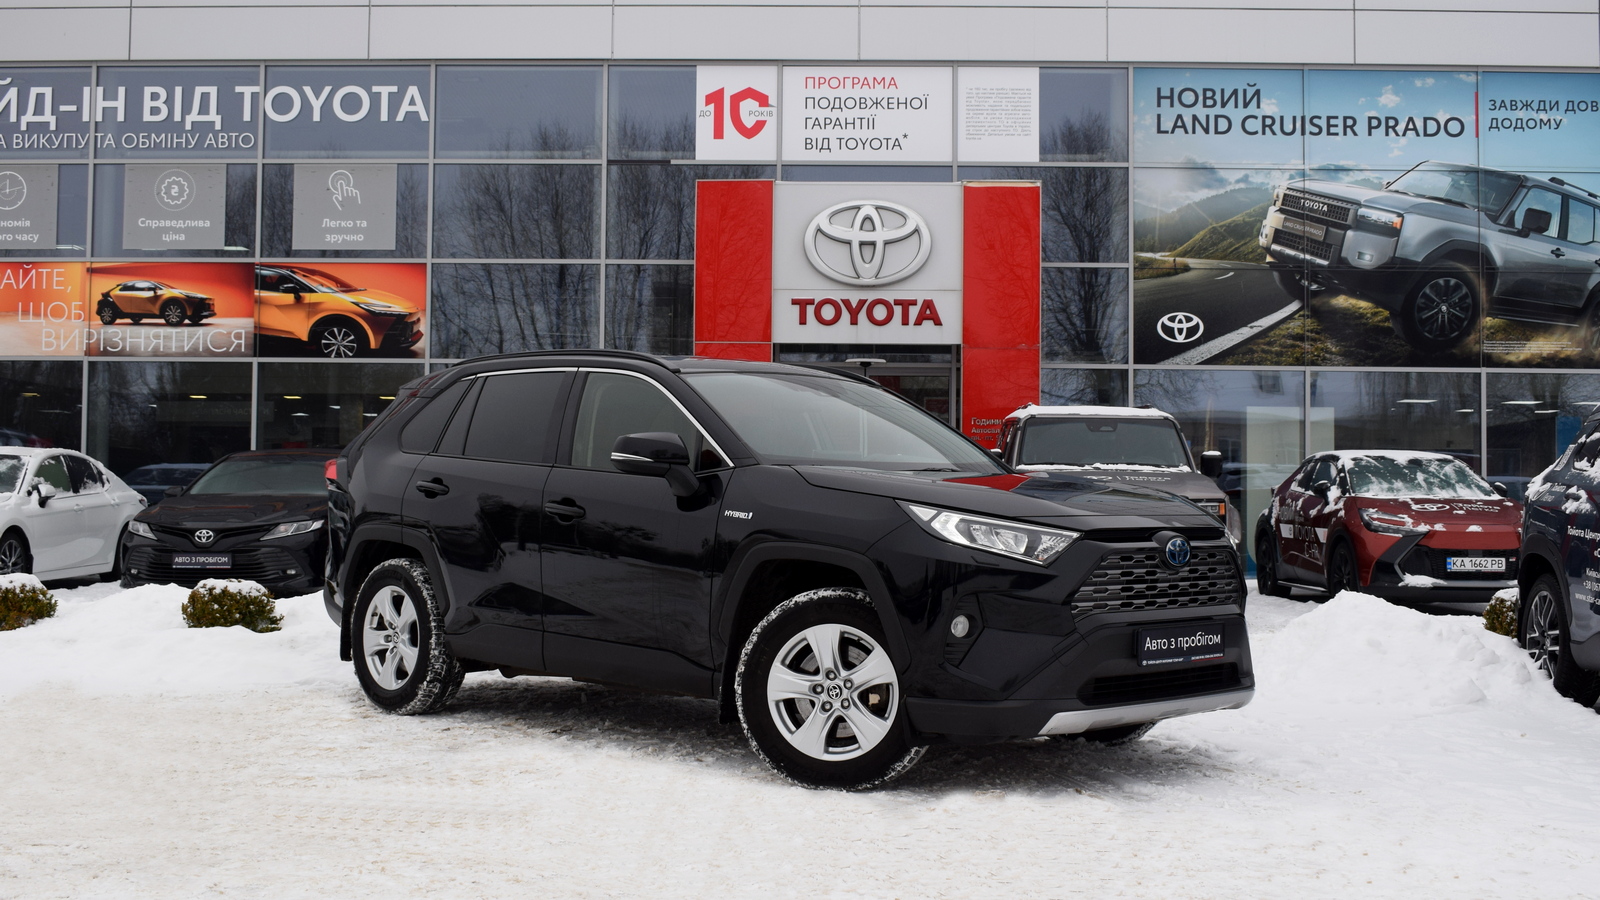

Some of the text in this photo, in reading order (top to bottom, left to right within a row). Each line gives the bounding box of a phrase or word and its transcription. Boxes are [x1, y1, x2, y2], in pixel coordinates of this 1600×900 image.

[804, 76, 899, 90] ПРОГРАМА
[1156, 82, 1261, 109] НОВИЙ
[142, 85, 222, 131] ВІД
[235, 85, 430, 123] TOYOTA
[804, 94, 929, 113] ПОДОВЖЕНОЇ
[1488, 99, 1599, 115] ЗАВЖДИ ДОВ
[698, 110, 712, 118] ДО
[748, 110, 774, 118] РОКІВ
[804, 114, 877, 130] ГАРАНТІЇ
[1156, 113, 1465, 138] LAND CRUISER PRADO
[1488, 117, 1563, 132] ДОДОМУ
[13, 133, 90, 149] ВИКУПУ
[95, 133, 116, 148] ТА
[121, 132, 200, 149] ОБМІНУ
[204, 132, 255, 149] АВТО
[804, 137, 832, 153] ВІД
[1300, 199, 1328, 212] TOYOTA
[0, 217, 31, 228] номія
[138, 218, 211, 228] Справедлива
[322, 218, 367, 228] Легко та
[15, 233, 40, 243] часу
[162, 231, 186, 242] ціна
[325, 233, 364, 244] зручно
[18, 301, 85, 326] ЩОБ
[791, 297, 943, 327] TOYOTA
[41, 328, 246, 352] ВИРІЗНЯТИСЯ
[724, 510, 748, 519] HYBRID
[1567, 525, 1585, 538] Тойота
[1452, 558, 1504, 569] KA 1662 PB
[1144, 631, 1221, 651] Авто з пробігом
